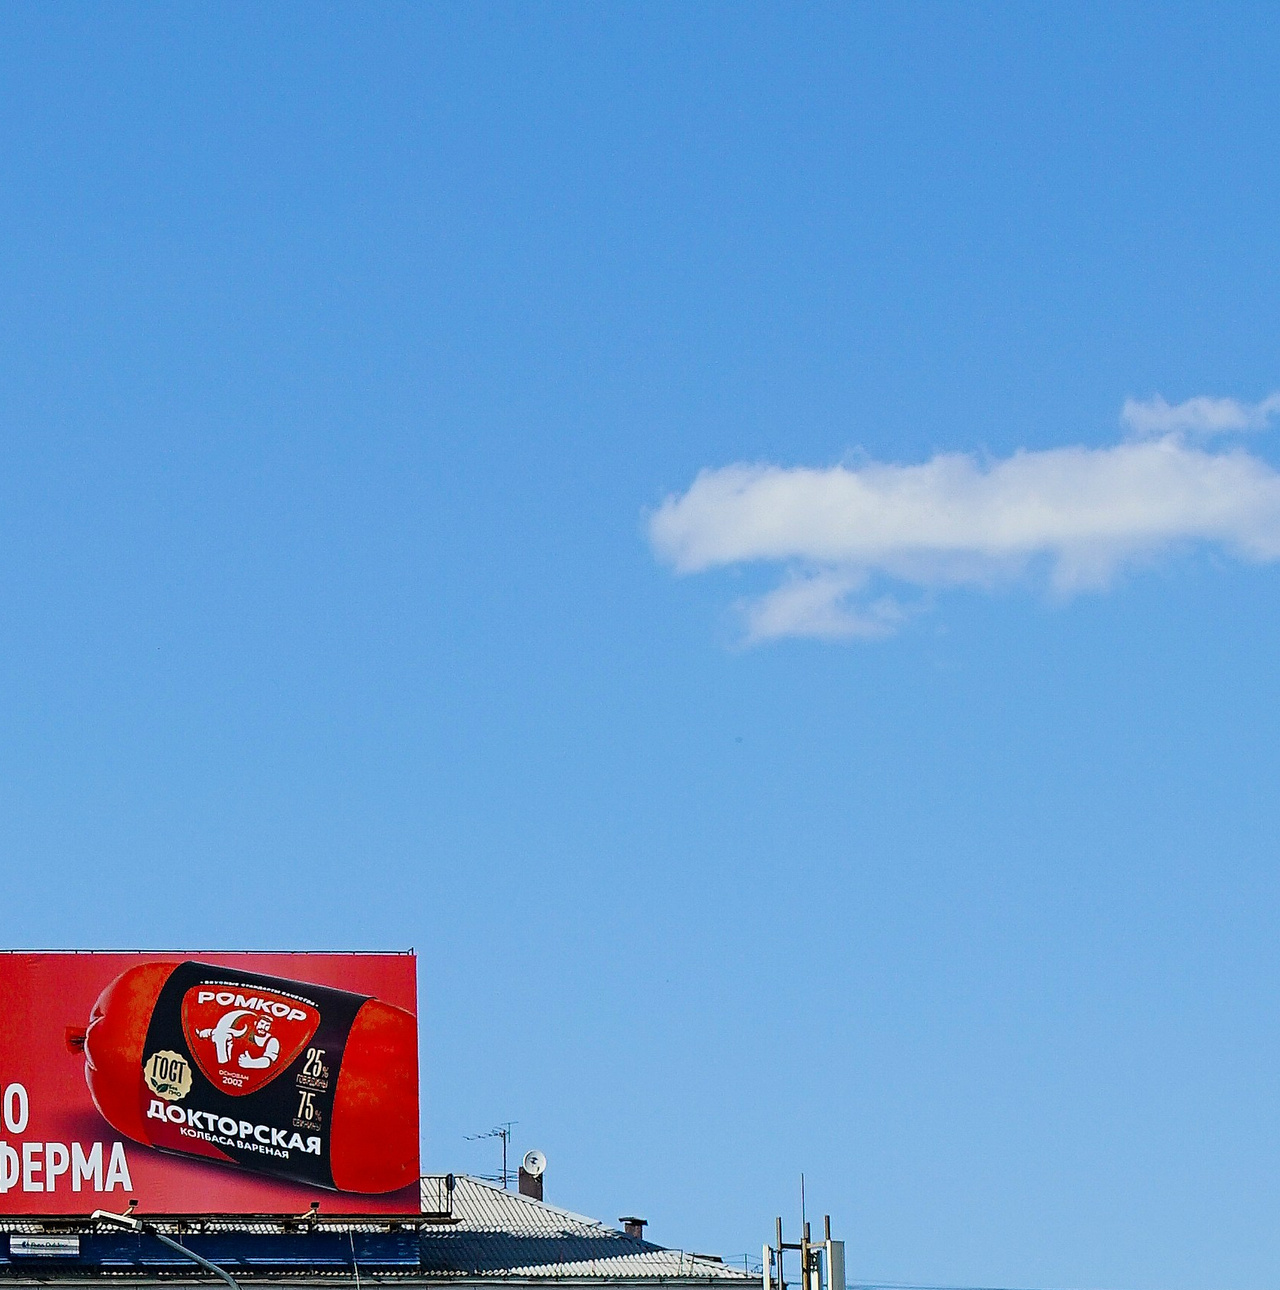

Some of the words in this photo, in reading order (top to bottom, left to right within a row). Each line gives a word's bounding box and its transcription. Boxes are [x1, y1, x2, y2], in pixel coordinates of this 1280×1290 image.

[197, 991, 307, 1021] РОМКОР
[152, 1055, 186, 1084] ГОСТ
[222, 1076, 243, 1087] 2002
[147, 1100, 321, 1156] ДОКТОРСКАЯ
[180, 1127, 235, 1147] КОЛБАСА
[237, 1140, 290, 1159] ВАРЕНАЯ
